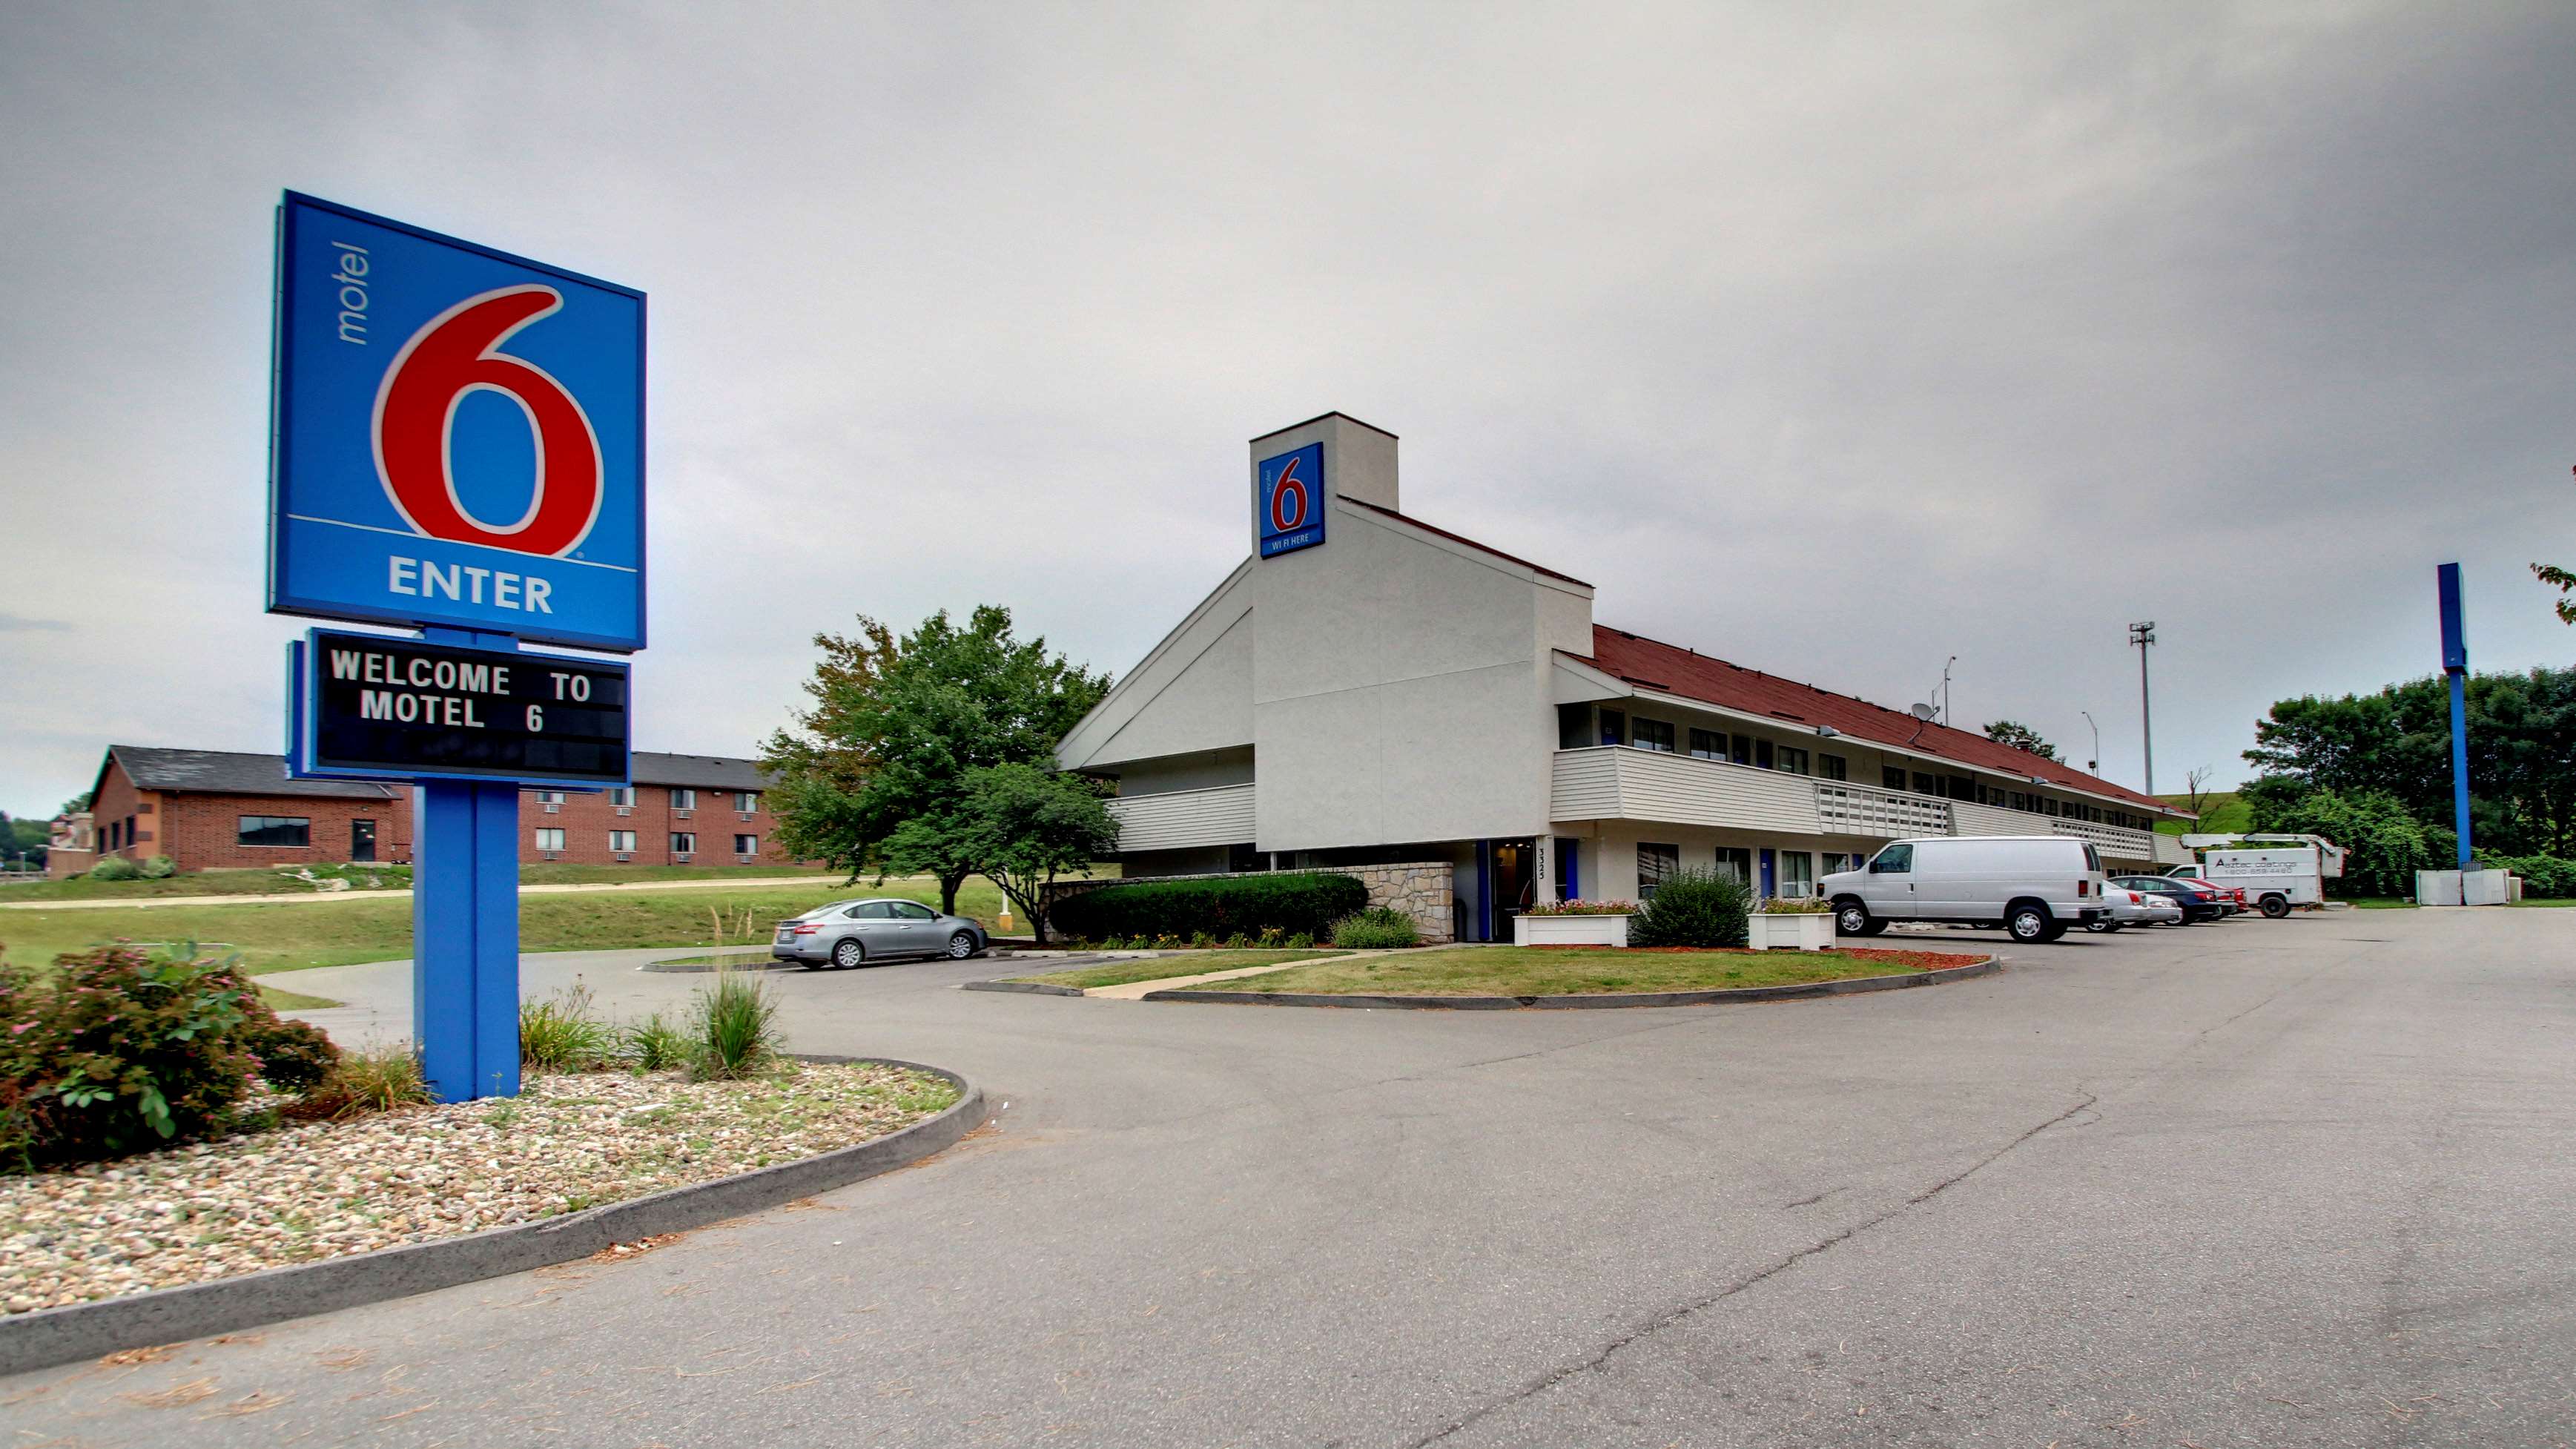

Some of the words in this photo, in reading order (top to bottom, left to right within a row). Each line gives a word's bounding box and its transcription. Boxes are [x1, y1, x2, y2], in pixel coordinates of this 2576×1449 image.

[331, 241, 369, 346] motel
[371, 283, 605, 559] 6
[1271, 456, 1307, 532] 6
[1272, 541, 1281, 550] WI
[1284, 538, 1289, 547] FI
[1291, 533, 1309, 546] HERE
[389, 555, 554, 614] ENTER
[331, 649, 509, 696] WELCOME
[550, 672, 591, 702] TO
[360, 690, 484, 727] MOTEL
[526, 704, 543, 732] 6
